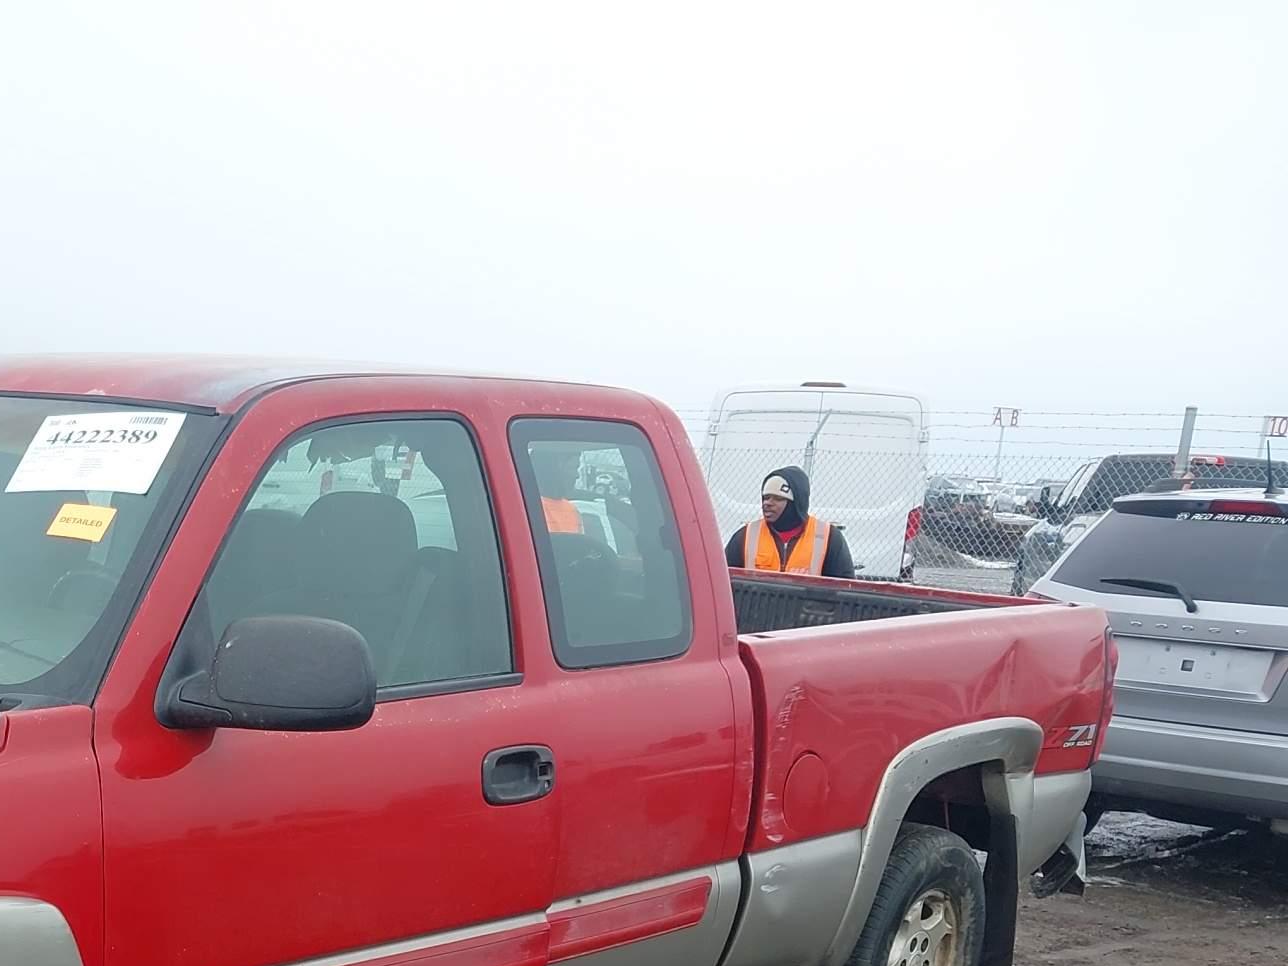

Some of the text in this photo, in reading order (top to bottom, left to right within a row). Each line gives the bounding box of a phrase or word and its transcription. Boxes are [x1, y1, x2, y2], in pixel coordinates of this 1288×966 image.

[993, 407, 1019, 426] A B
[46, 430, 158, 444] 44222389
[59, 517, 103, 527] DETAILED
[1214, 514, 1246, 522] RIVER
[1246, 516, 1288, 524] EDITION
